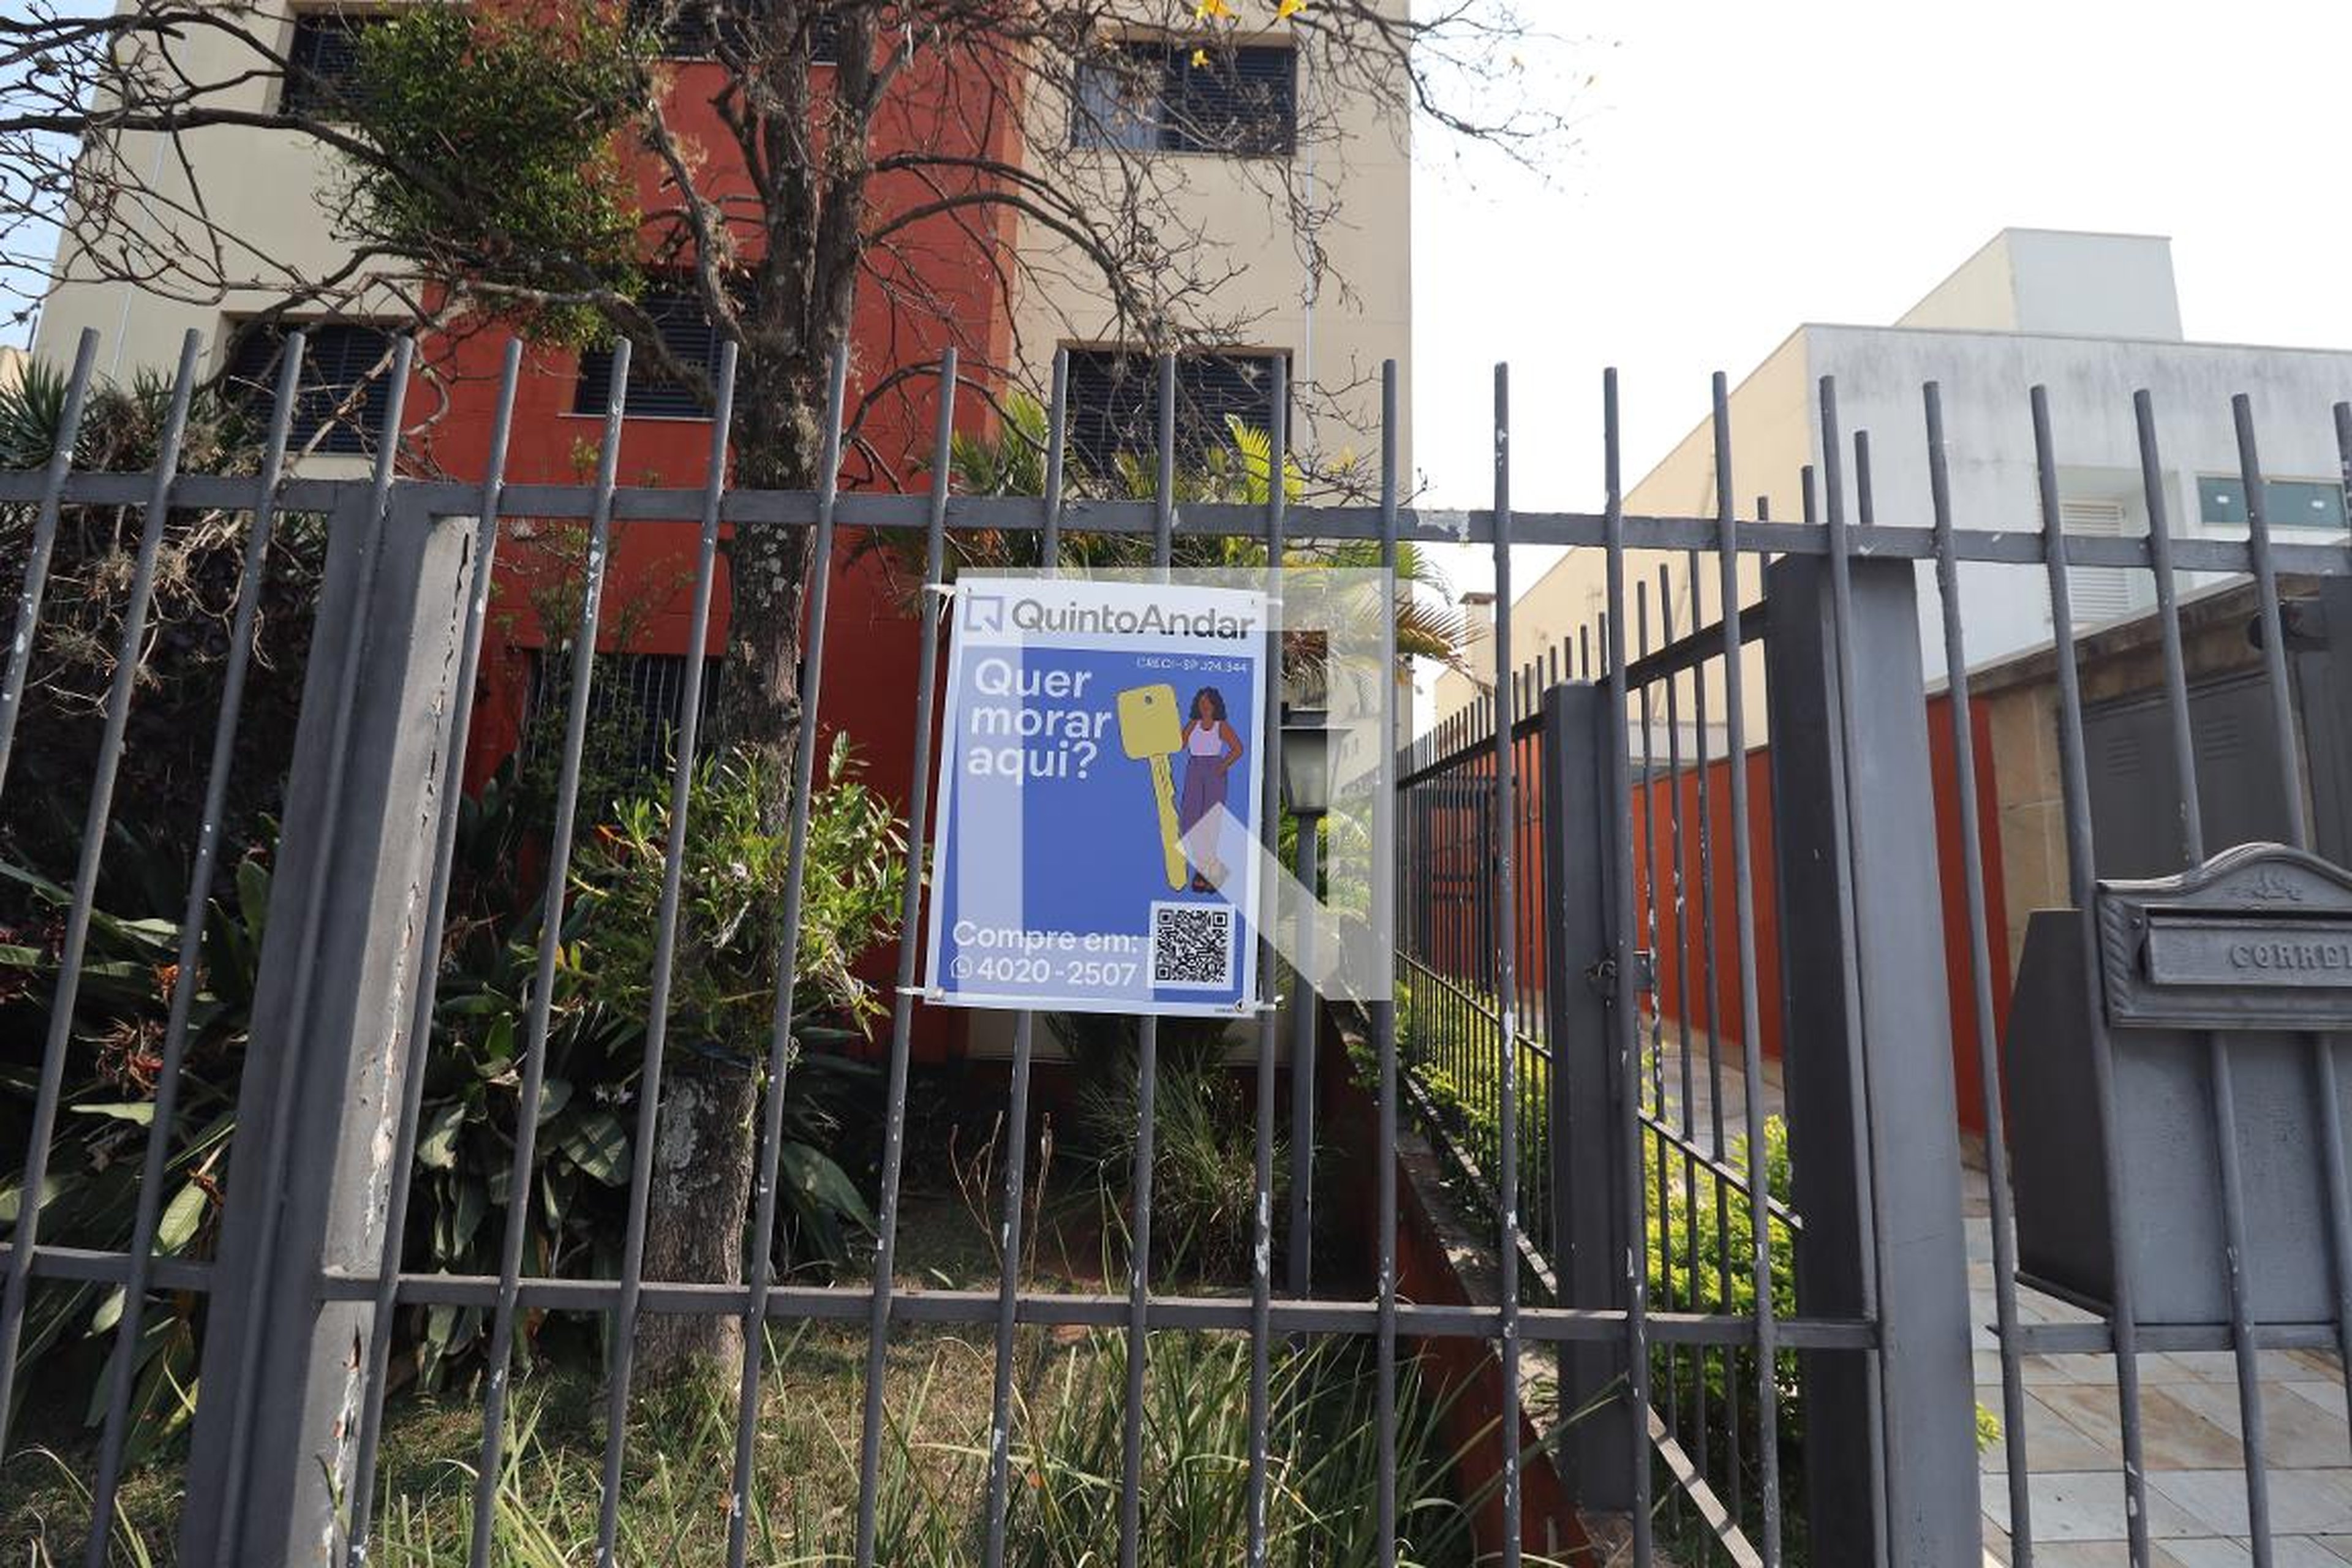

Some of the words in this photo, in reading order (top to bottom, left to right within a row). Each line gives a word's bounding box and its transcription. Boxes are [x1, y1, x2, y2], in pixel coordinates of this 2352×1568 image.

[1012, 598, 1256, 640] QuintoAndar
[975, 658, 1093, 698] Quer
[971, 706, 1112, 739] morar
[967, 740, 1098, 786] aqui?
[952, 920, 1076, 955] Compre
[1085, 932, 1138, 953] em:
[978, 956, 1137, 986] 4020-2507
